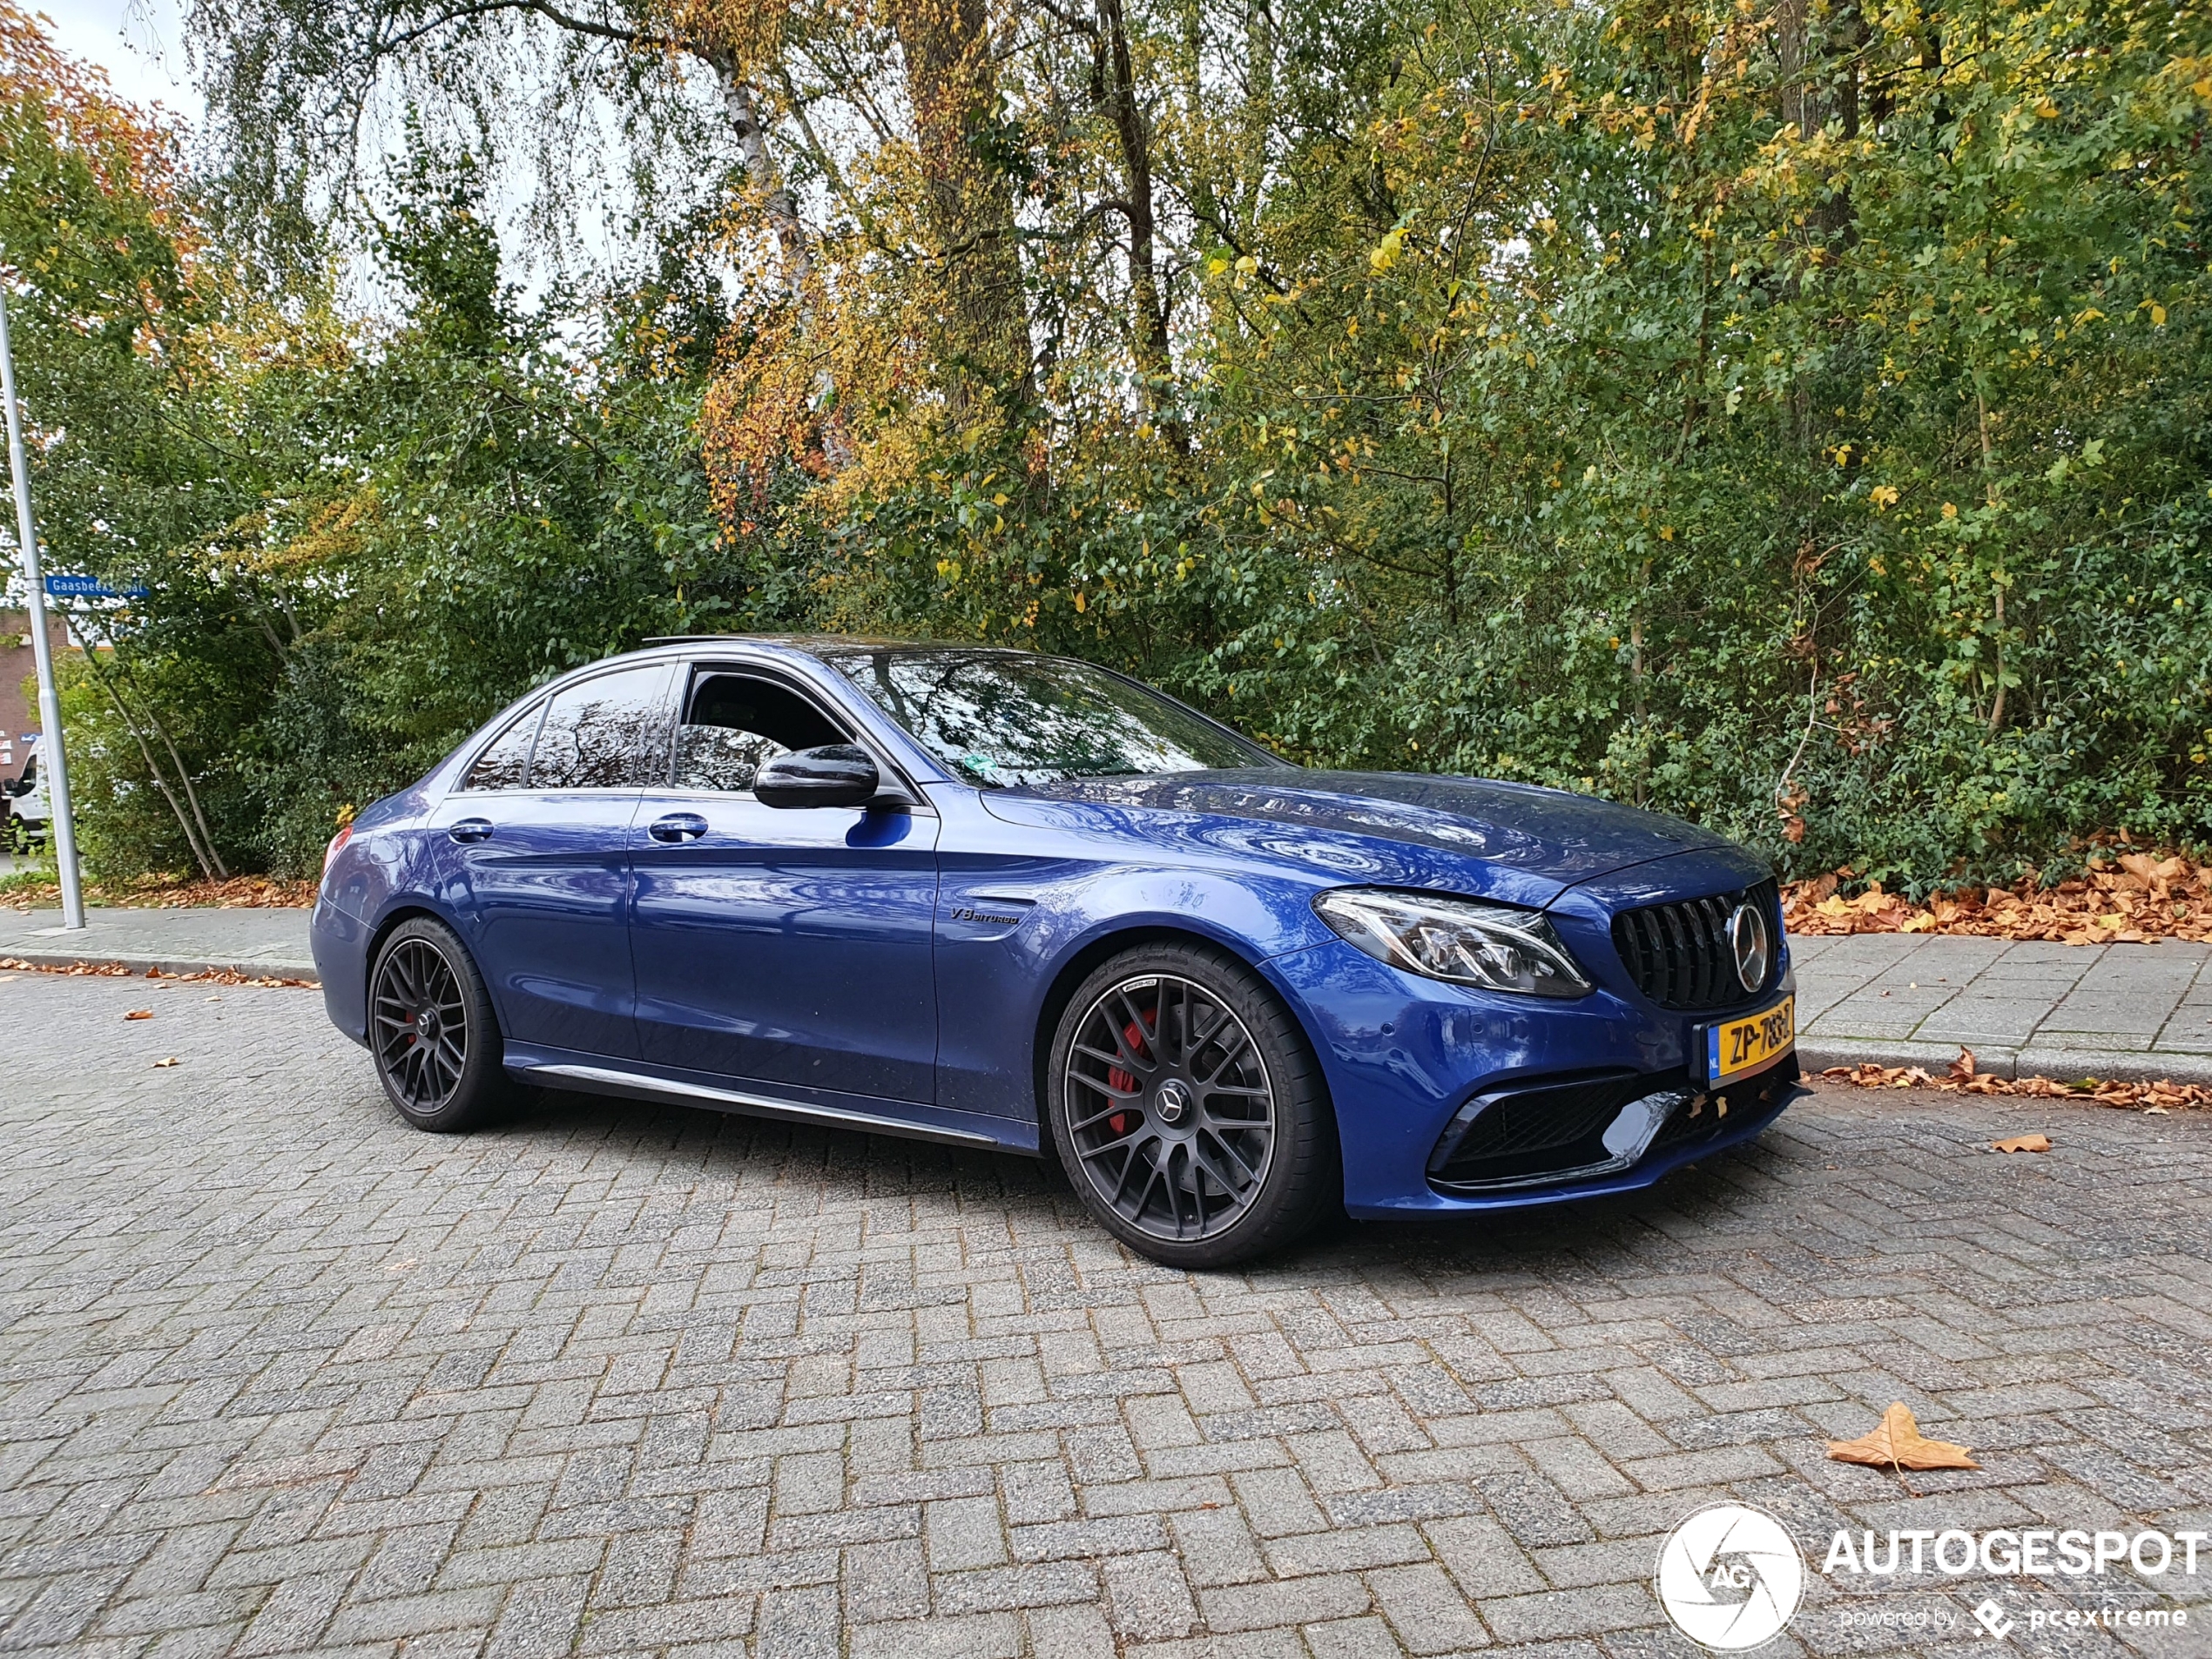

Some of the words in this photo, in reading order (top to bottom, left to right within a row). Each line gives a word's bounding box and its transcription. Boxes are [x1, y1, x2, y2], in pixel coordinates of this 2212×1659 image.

[951, 907, 974, 921] V8
[974, 914, 1019, 924] BITURBO
[1710, 1057, 1718, 1069] NL
